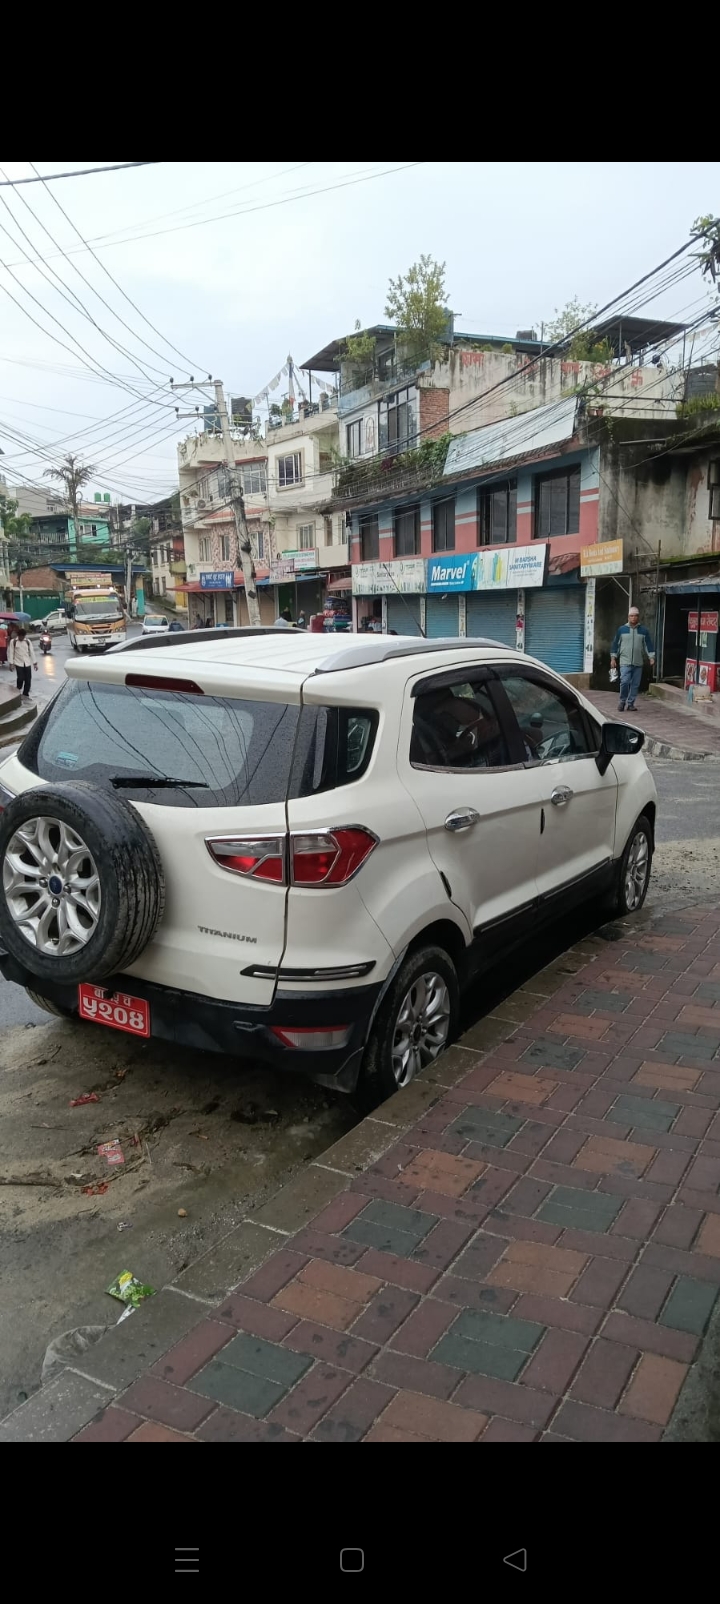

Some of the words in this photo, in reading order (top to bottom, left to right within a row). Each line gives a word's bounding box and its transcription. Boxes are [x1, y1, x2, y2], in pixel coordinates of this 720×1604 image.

[431, 562, 467, 581] Marvel
[197, 925, 257, 944] TITANIUM
[82, 996, 145, 1030] ५२०४
